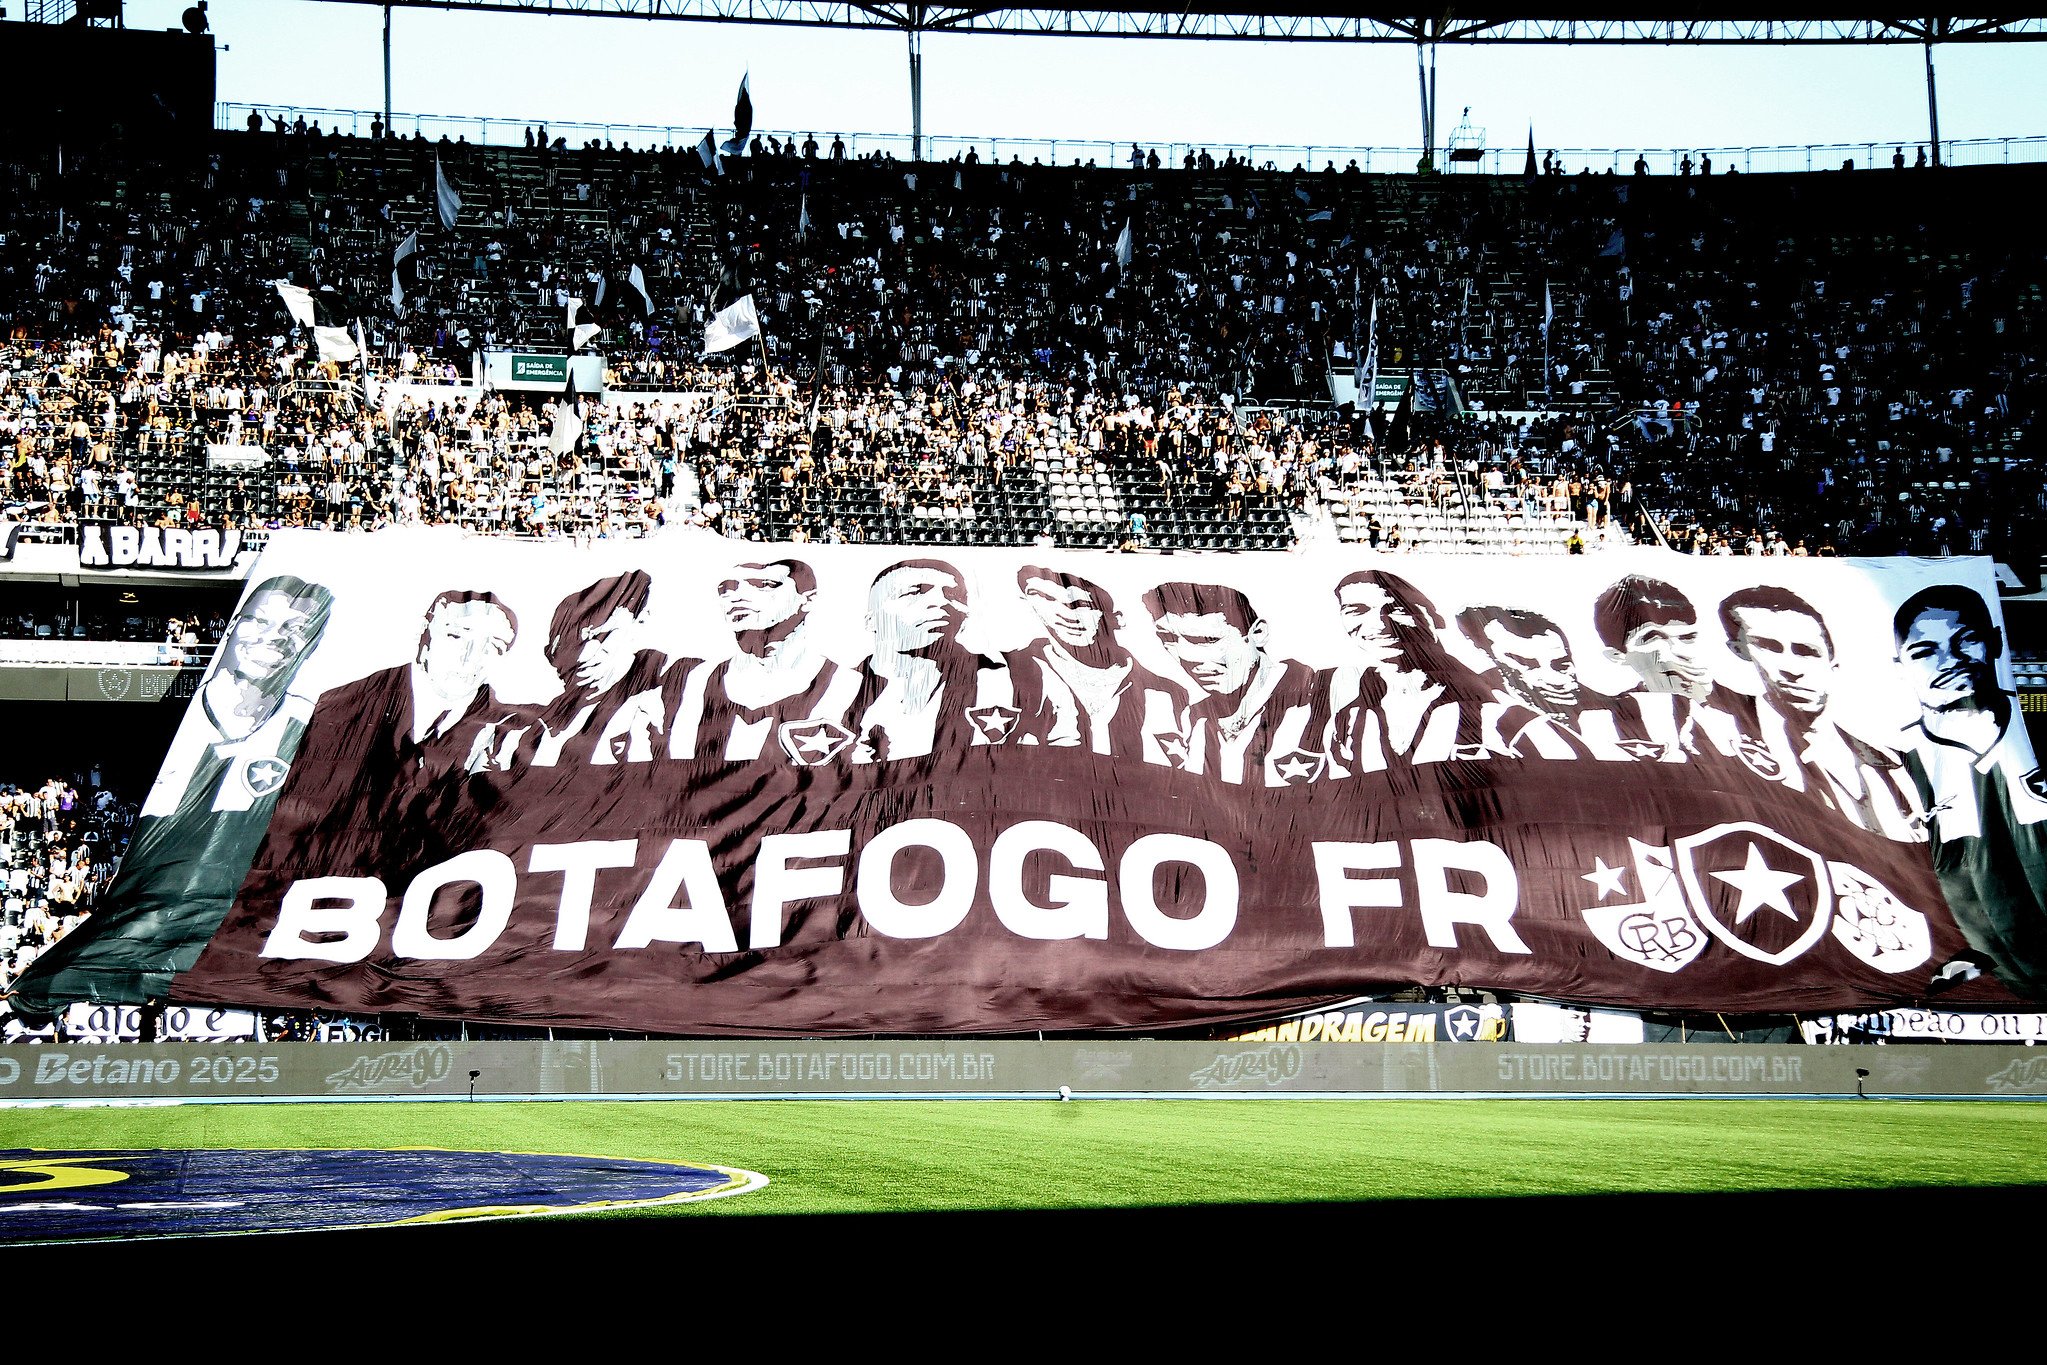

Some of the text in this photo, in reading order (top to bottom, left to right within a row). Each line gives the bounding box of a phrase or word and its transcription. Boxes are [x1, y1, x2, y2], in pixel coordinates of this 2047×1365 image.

[526, 361, 545, 369] SAÍDA
[526, 368, 564, 376] EMERGÊNCIA
[258, 819, 1533, 962] BOTAFOGO FR
[1227, 1011, 1437, 1042] ANDRAGEM
[34, 1053, 181, 1084] Betano
[189, 1056, 280, 1084] 2025
[666, 1053, 995, 1081] STORE.BOTAFOGO.COM.BR
[1498, 1054, 1802, 1082] STORE.BOTAFOGO.COM.BR
